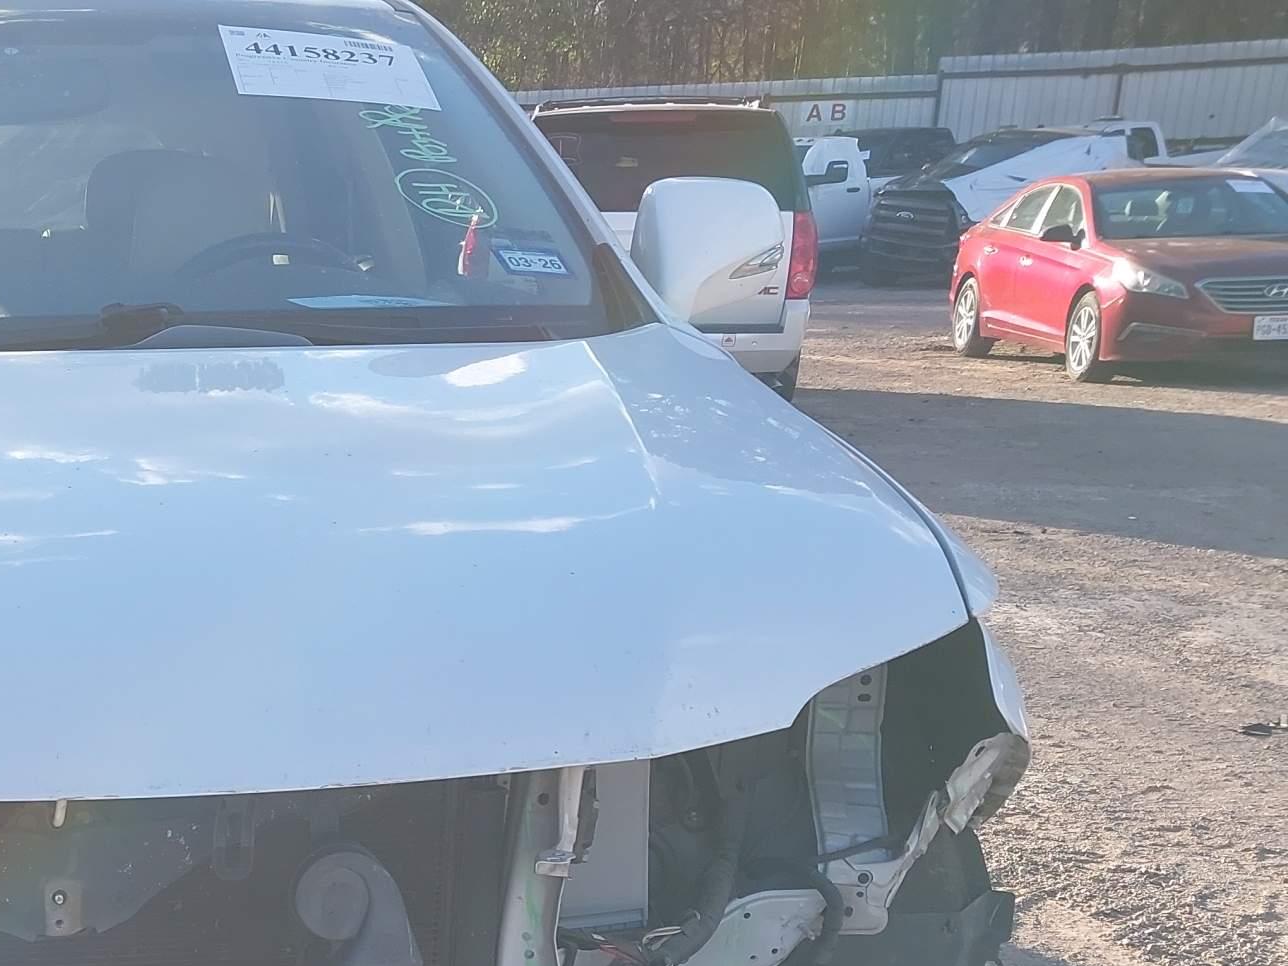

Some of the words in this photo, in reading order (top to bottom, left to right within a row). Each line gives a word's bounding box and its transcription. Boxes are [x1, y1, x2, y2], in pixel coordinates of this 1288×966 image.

[245, 41, 394, 67] 44158237
[806, 103, 822, 122] A
[831, 103, 846, 121] B
